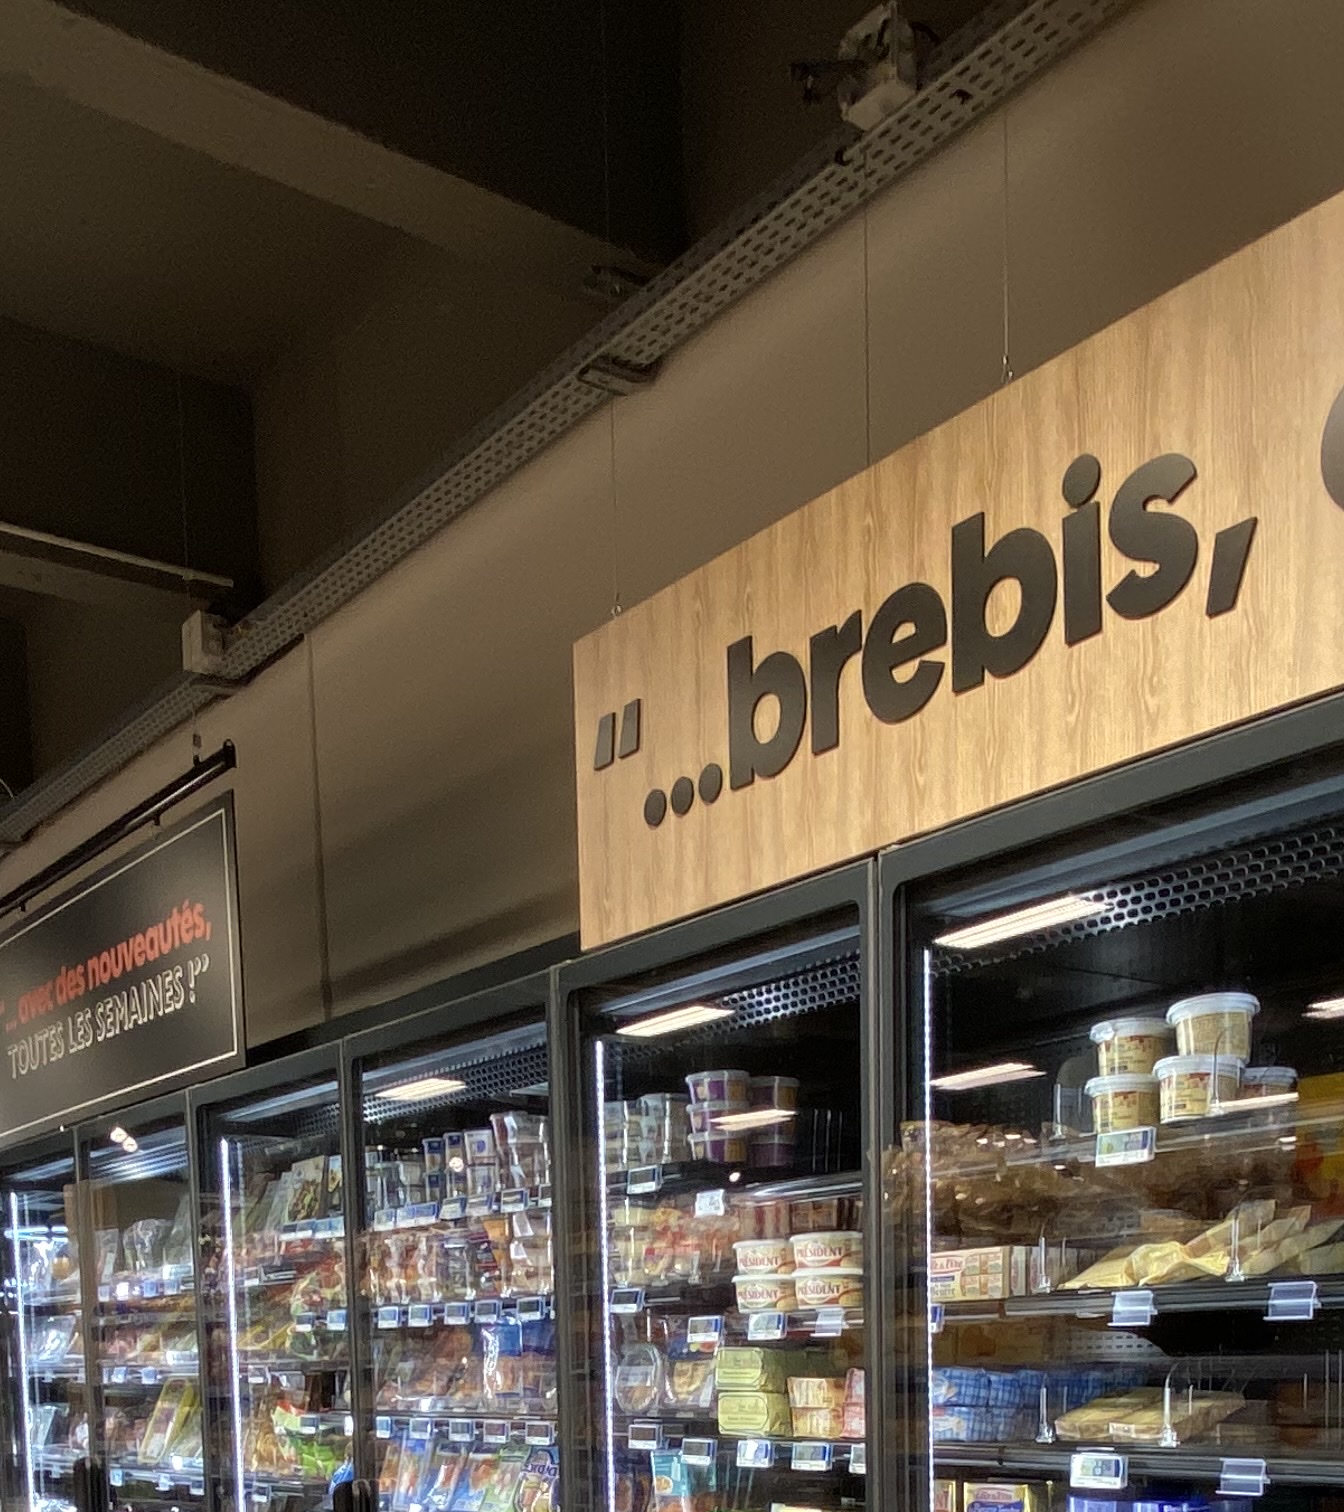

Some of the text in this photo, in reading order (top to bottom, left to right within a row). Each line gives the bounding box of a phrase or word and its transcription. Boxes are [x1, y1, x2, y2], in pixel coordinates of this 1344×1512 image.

[7, 1022, 65, 1081] TOUTES
[68, 1007, 93, 1055] LES
[96, 964, 186, 1043] SEMAINES
[57, 961, 86, 1006] des
